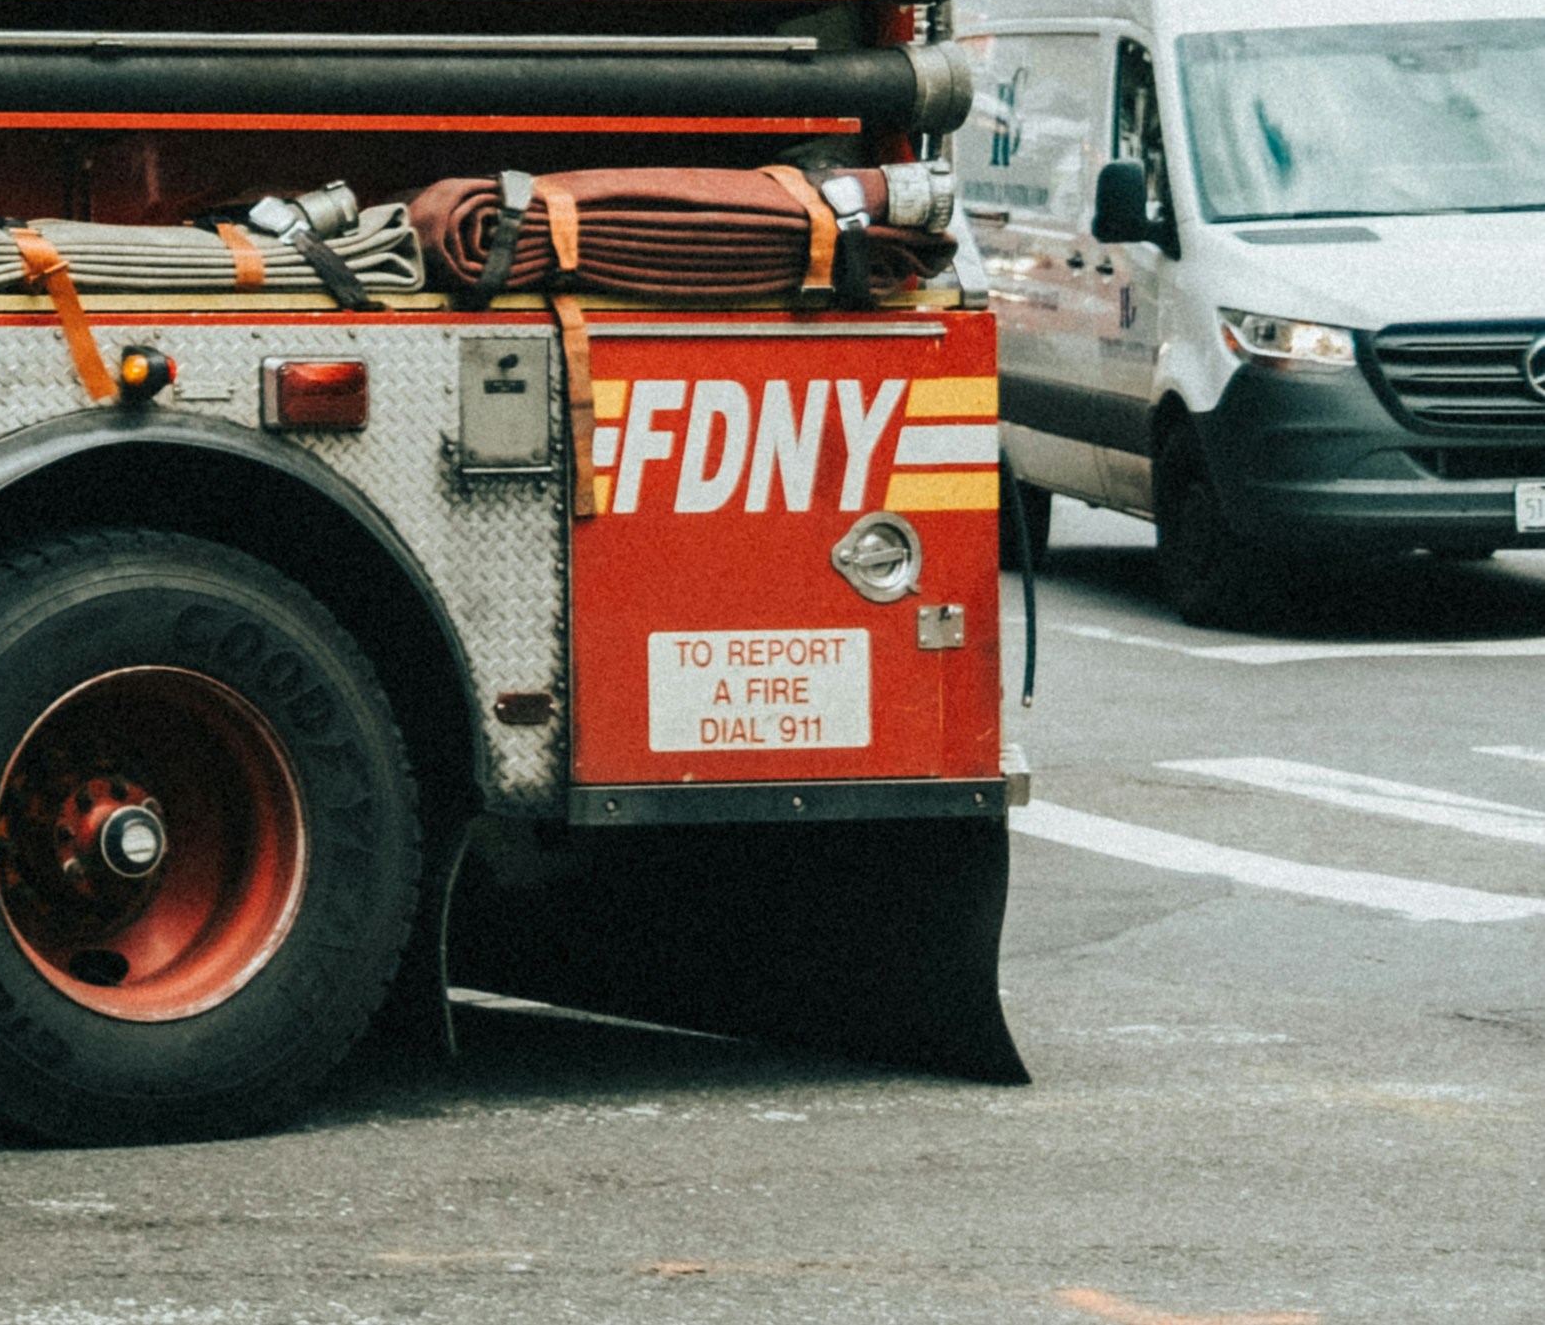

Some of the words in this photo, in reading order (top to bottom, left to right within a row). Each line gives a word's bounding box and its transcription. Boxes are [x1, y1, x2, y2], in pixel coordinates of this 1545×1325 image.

[612, 379, 908, 514] FDNY
[676, 641, 713, 668] TO
[726, 637, 846, 667] REPORT
[712, 679, 732, 705] A
[746, 677, 810, 705] FIRE
[699, 717, 765, 744] DIAL
[779, 716, 823, 743] 911
